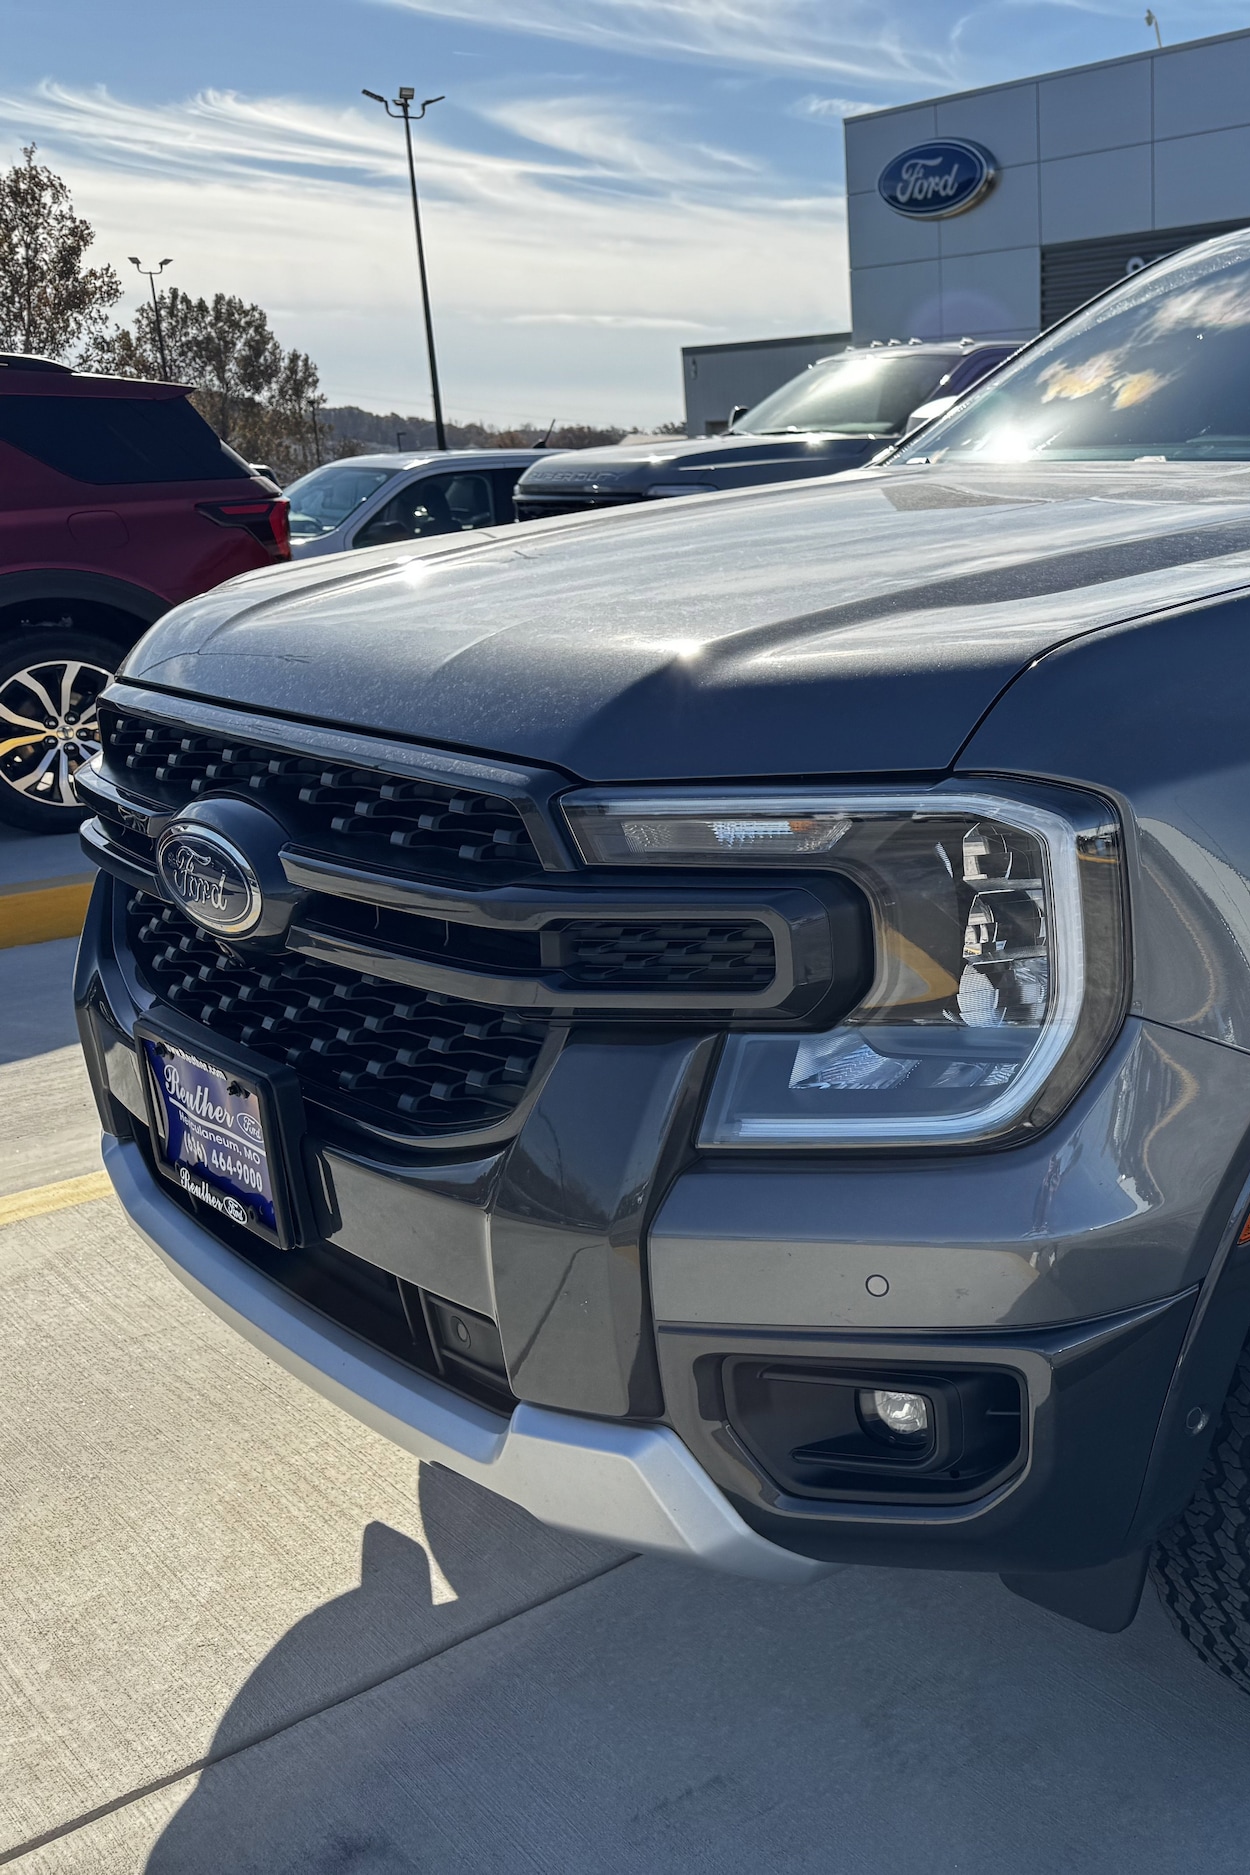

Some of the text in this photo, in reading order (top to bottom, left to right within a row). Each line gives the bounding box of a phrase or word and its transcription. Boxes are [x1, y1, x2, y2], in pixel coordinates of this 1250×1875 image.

[896, 156, 959, 203] Ford
[174, 845, 228, 911] Ford
[163, 1064, 235, 1128] Reuther
[178, 1110, 261, 1165] Herculaneum, MO
[180, 1167, 224, 1212] Reuther
[211, 1149, 263, 1193] 464-9000
